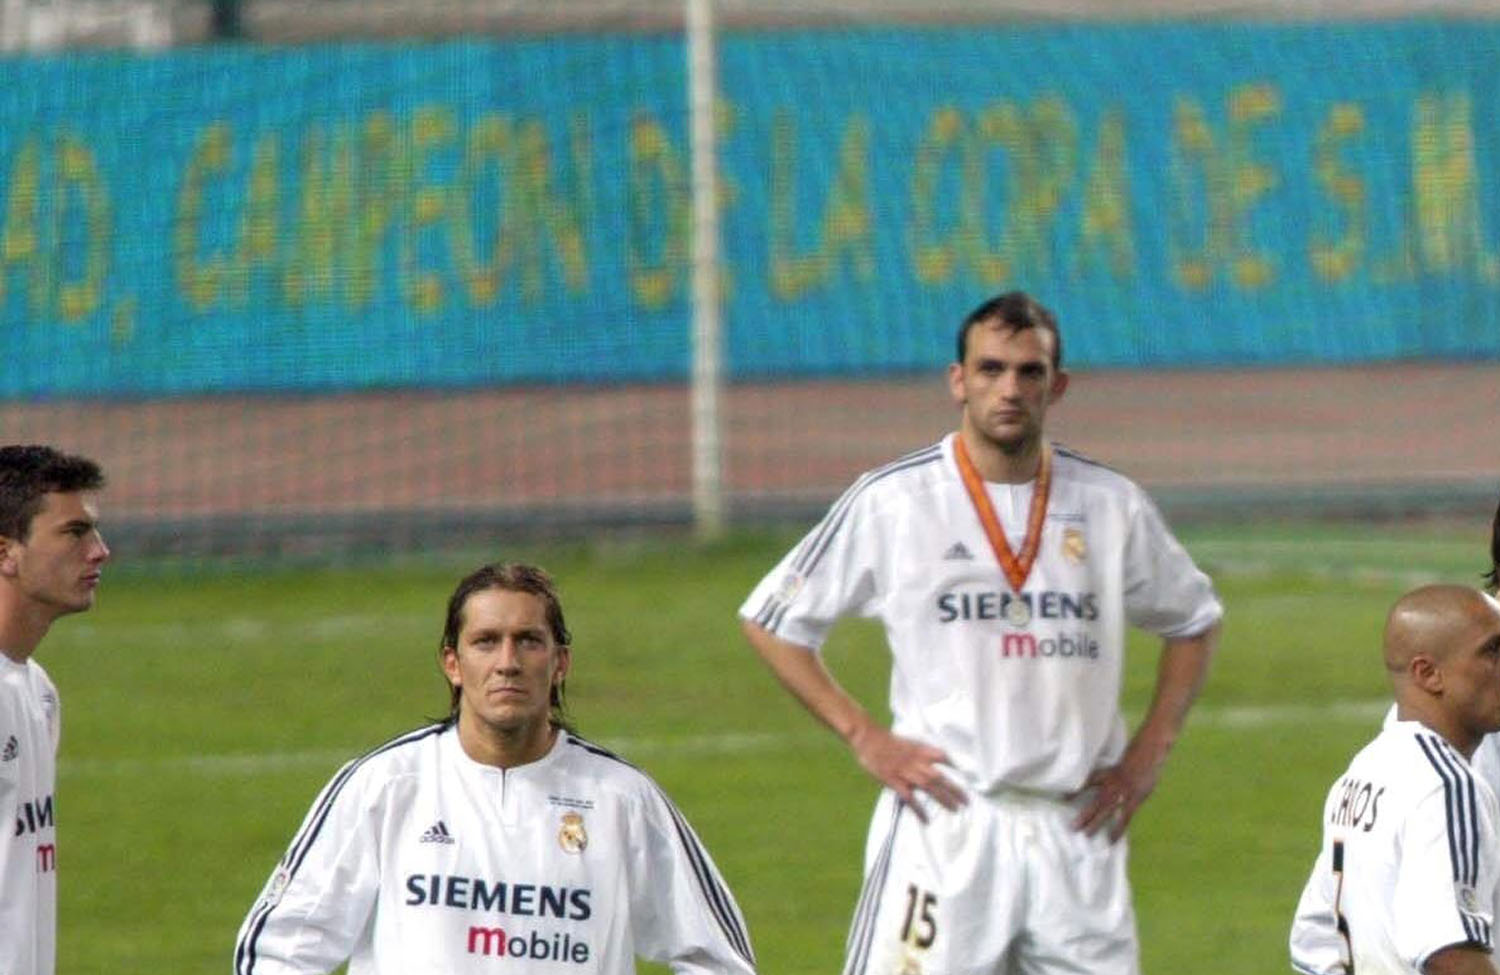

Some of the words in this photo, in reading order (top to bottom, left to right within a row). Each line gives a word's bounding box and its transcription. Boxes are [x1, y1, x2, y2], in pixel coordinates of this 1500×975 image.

[768, 104, 874, 302] LA
[910, 88, 1138, 286] COPA
[1170, 80, 1284, 290] DE
[1002, 630, 1100, 660] mobile
[405, 873, 592, 922] SIEMENS
[900, 882, 938, 951] 15
[466, 926, 590, 964] mobile
